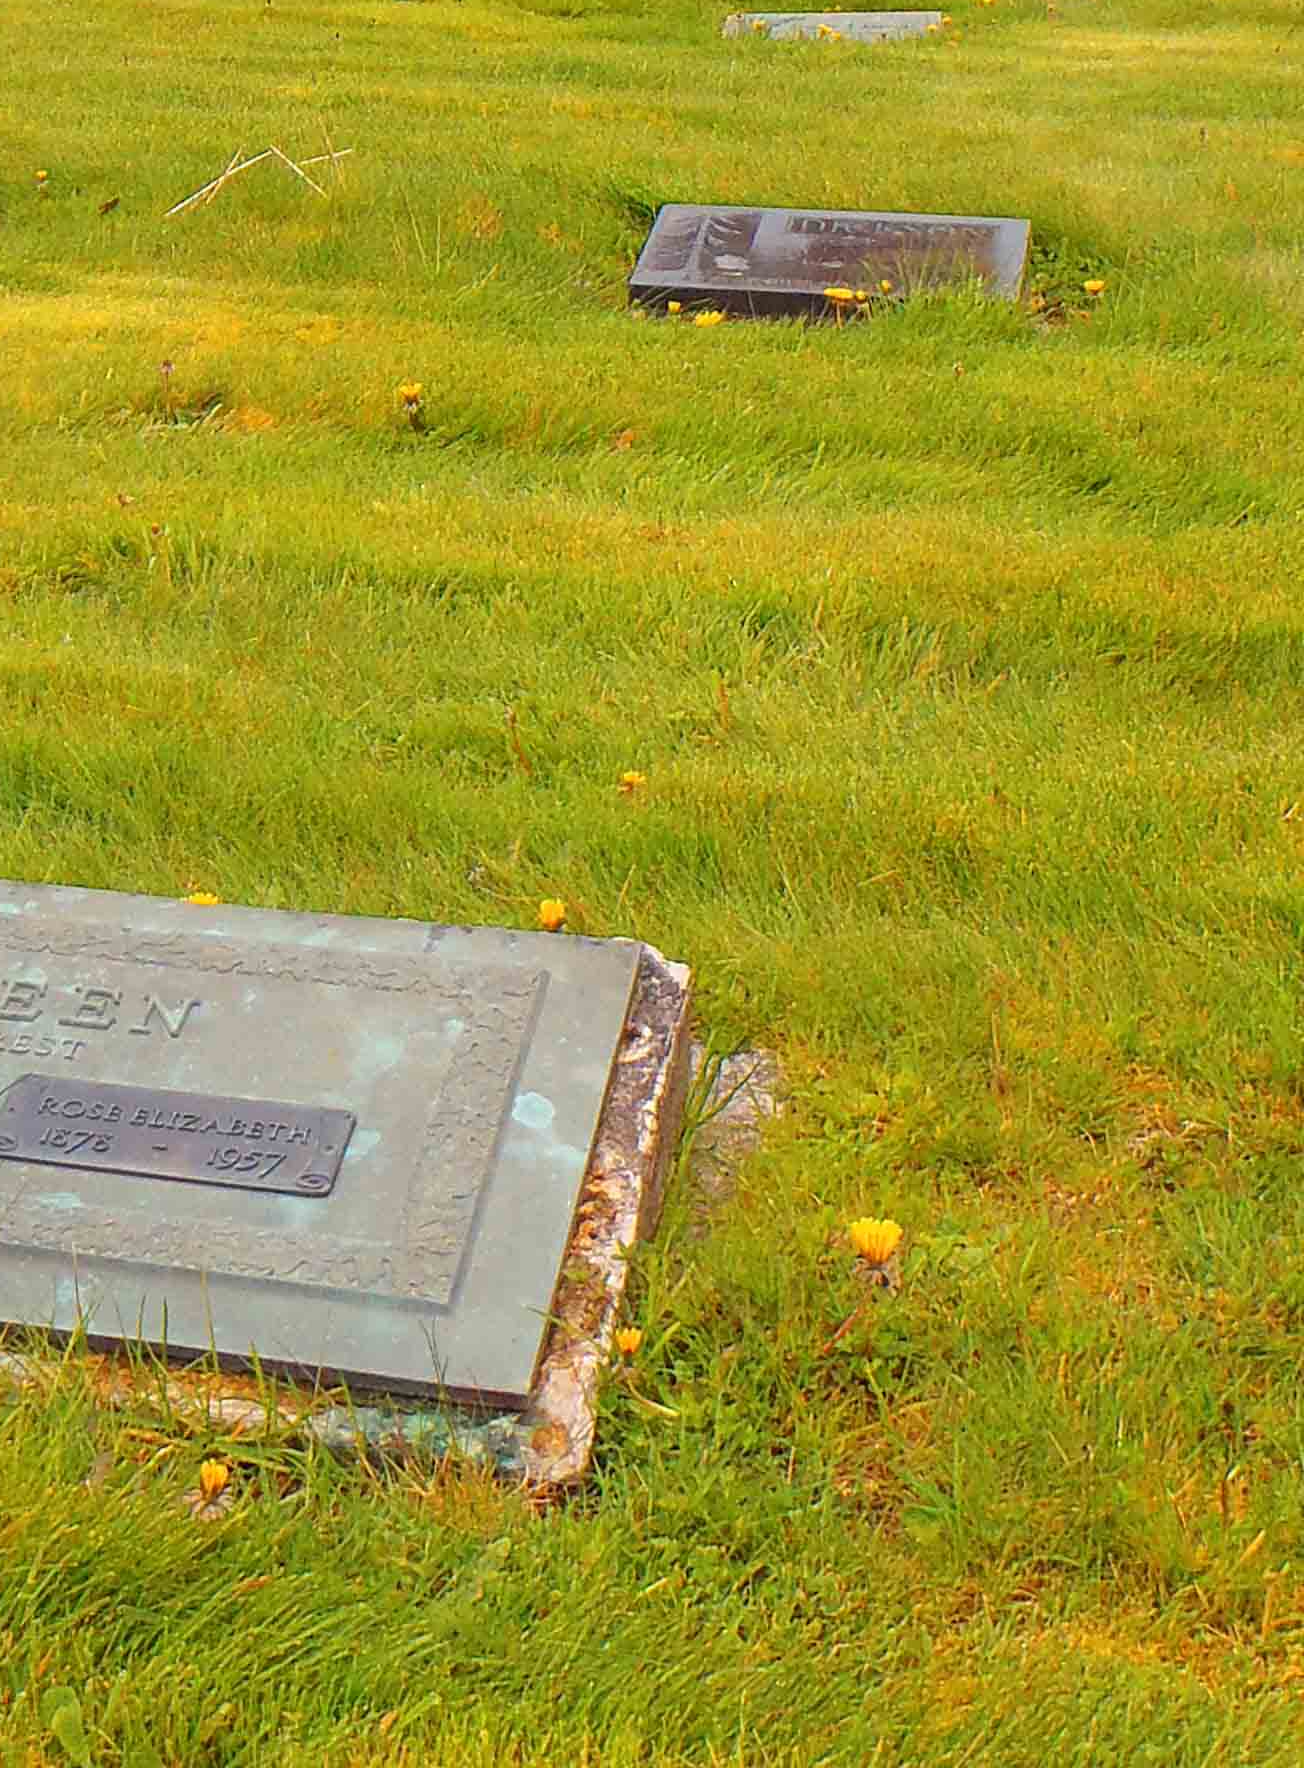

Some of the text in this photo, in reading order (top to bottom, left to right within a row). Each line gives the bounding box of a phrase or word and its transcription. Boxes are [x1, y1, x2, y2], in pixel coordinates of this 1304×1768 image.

[37, 1096, 313, 1145] ROSE ELIZABETH
[38, 1126, 115, 1155] 1878
[206, 1148, 289, 1180] 1957
